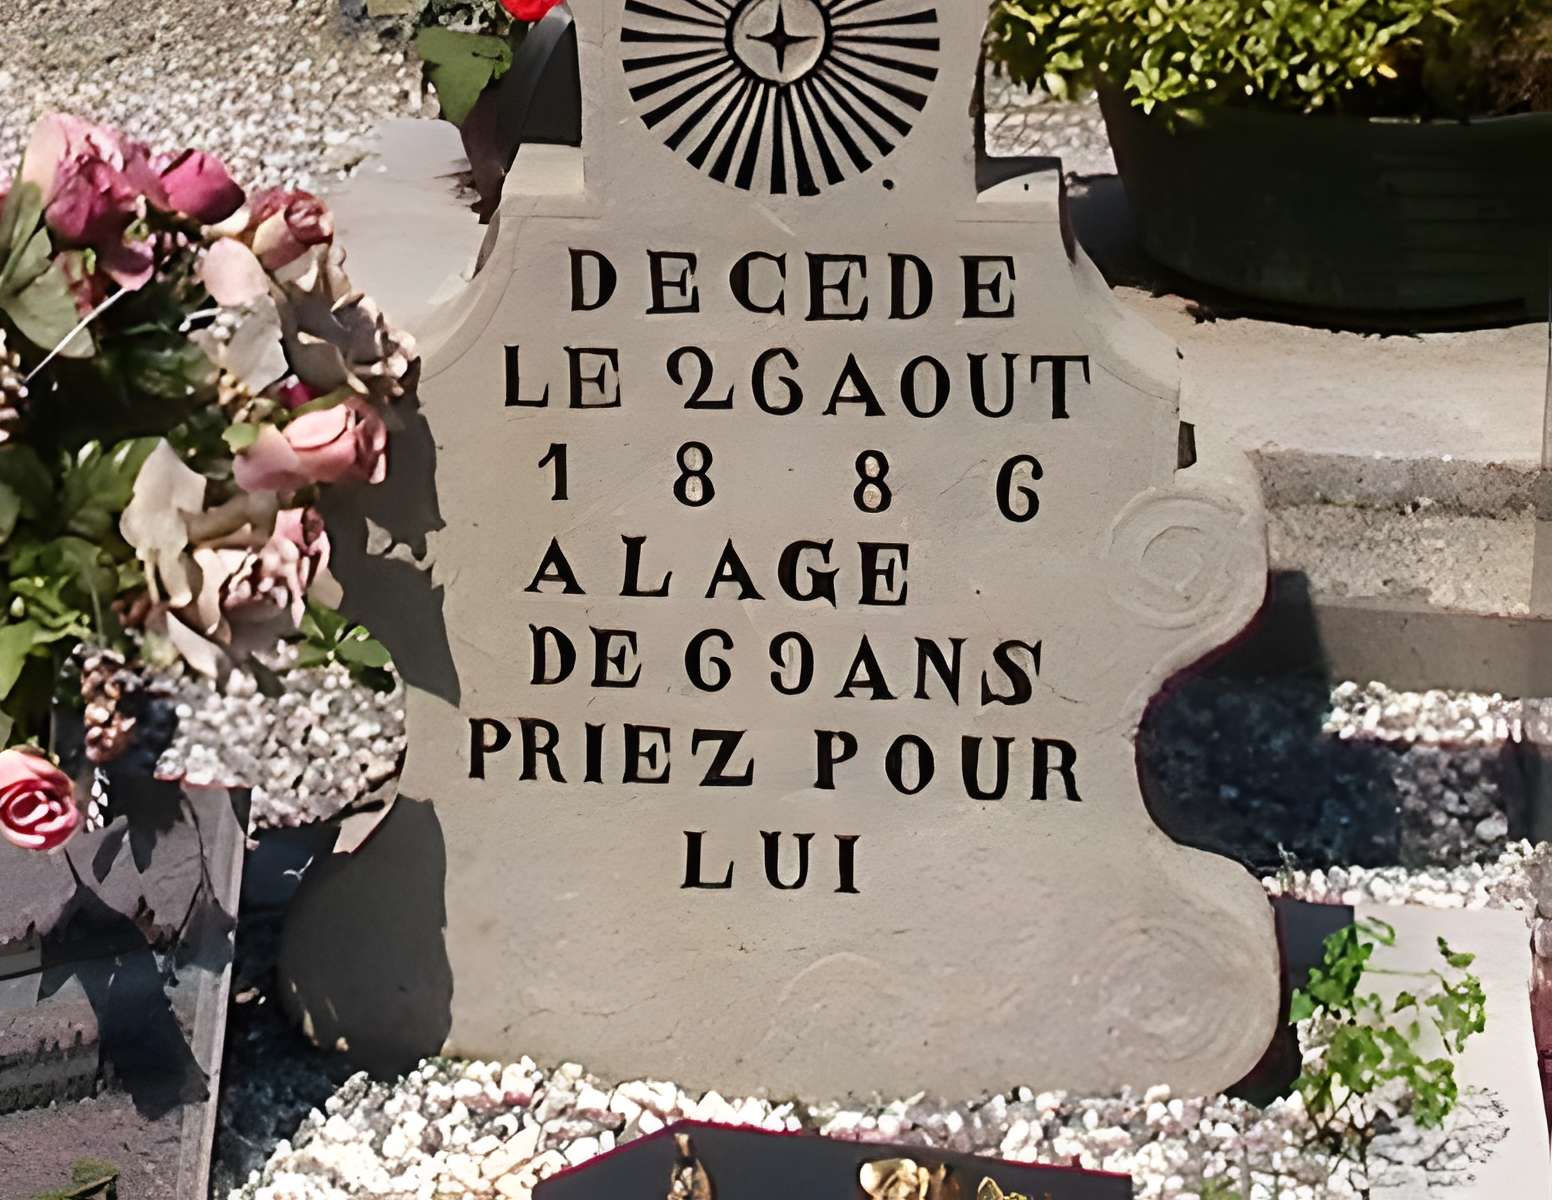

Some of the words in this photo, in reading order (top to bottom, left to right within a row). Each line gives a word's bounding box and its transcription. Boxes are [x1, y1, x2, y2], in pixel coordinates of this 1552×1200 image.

[569, 248, 1015, 321] DECEDE
[504, 345, 621, 409] LE
[667, 346, 803, 415] 26
[822, 353, 1090, 419] AOUT
[529, 624, 641, 688] DE
[685, 629, 814, 695] 69
[834, 634, 1042, 706] ANS
[469, 717, 754, 786] PRIEZ
[814, 730, 1082, 802] POUR
[680, 831, 860, 893] LUI
